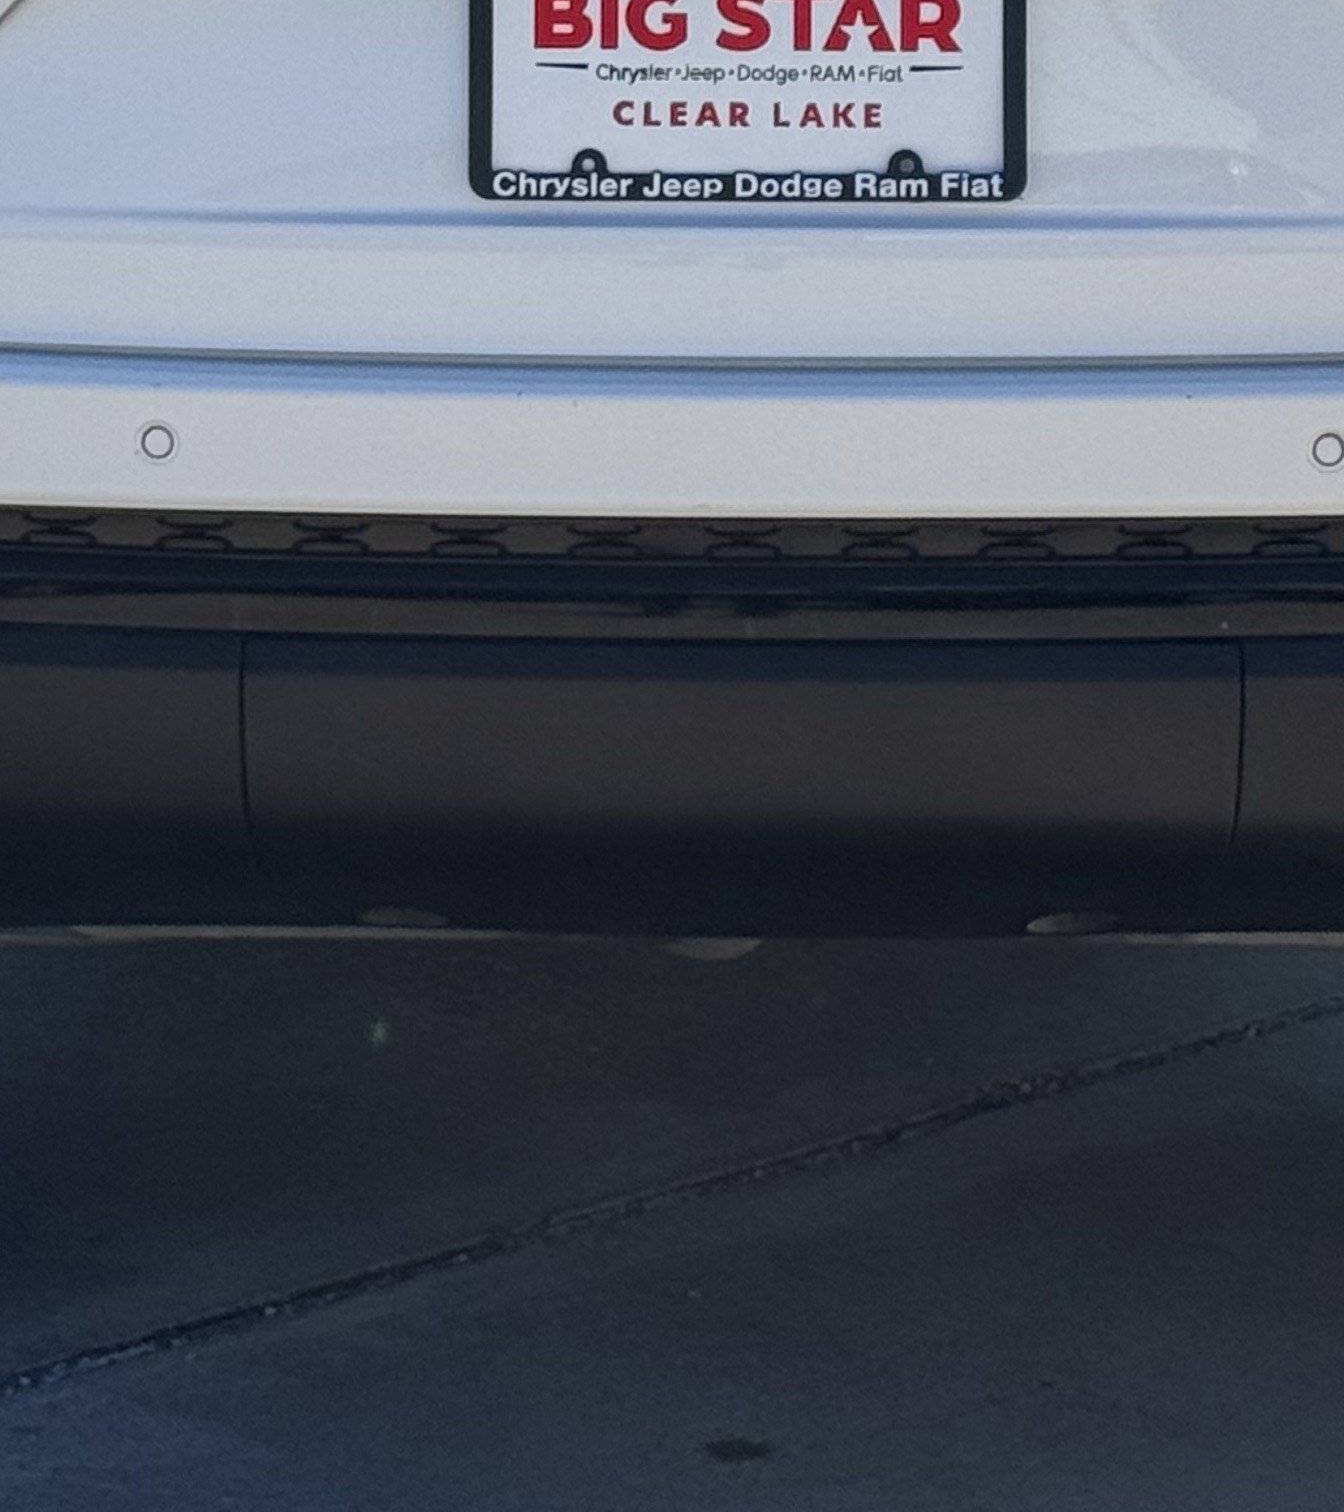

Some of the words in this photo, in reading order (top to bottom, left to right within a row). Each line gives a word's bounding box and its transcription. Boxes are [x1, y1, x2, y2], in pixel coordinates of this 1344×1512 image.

[595, 63, 672, 85] Chrysler
[681, 64, 725, 84] Jeep
[737, 64, 799, 86] Dodge
[810, 64, 856, 82] RAM
[867, 65, 903, 83] Fiat
[612, 100, 750, 127] CLEAR
[773, 101, 882, 128] LAKE
[492, 172, 634, 198] Chrysler
[642, 172, 723, 198] Jeep
[734, 173, 843, 198] Dodge
[854, 173, 928, 198] Ram
[941, 173, 1004, 198] Fiat
